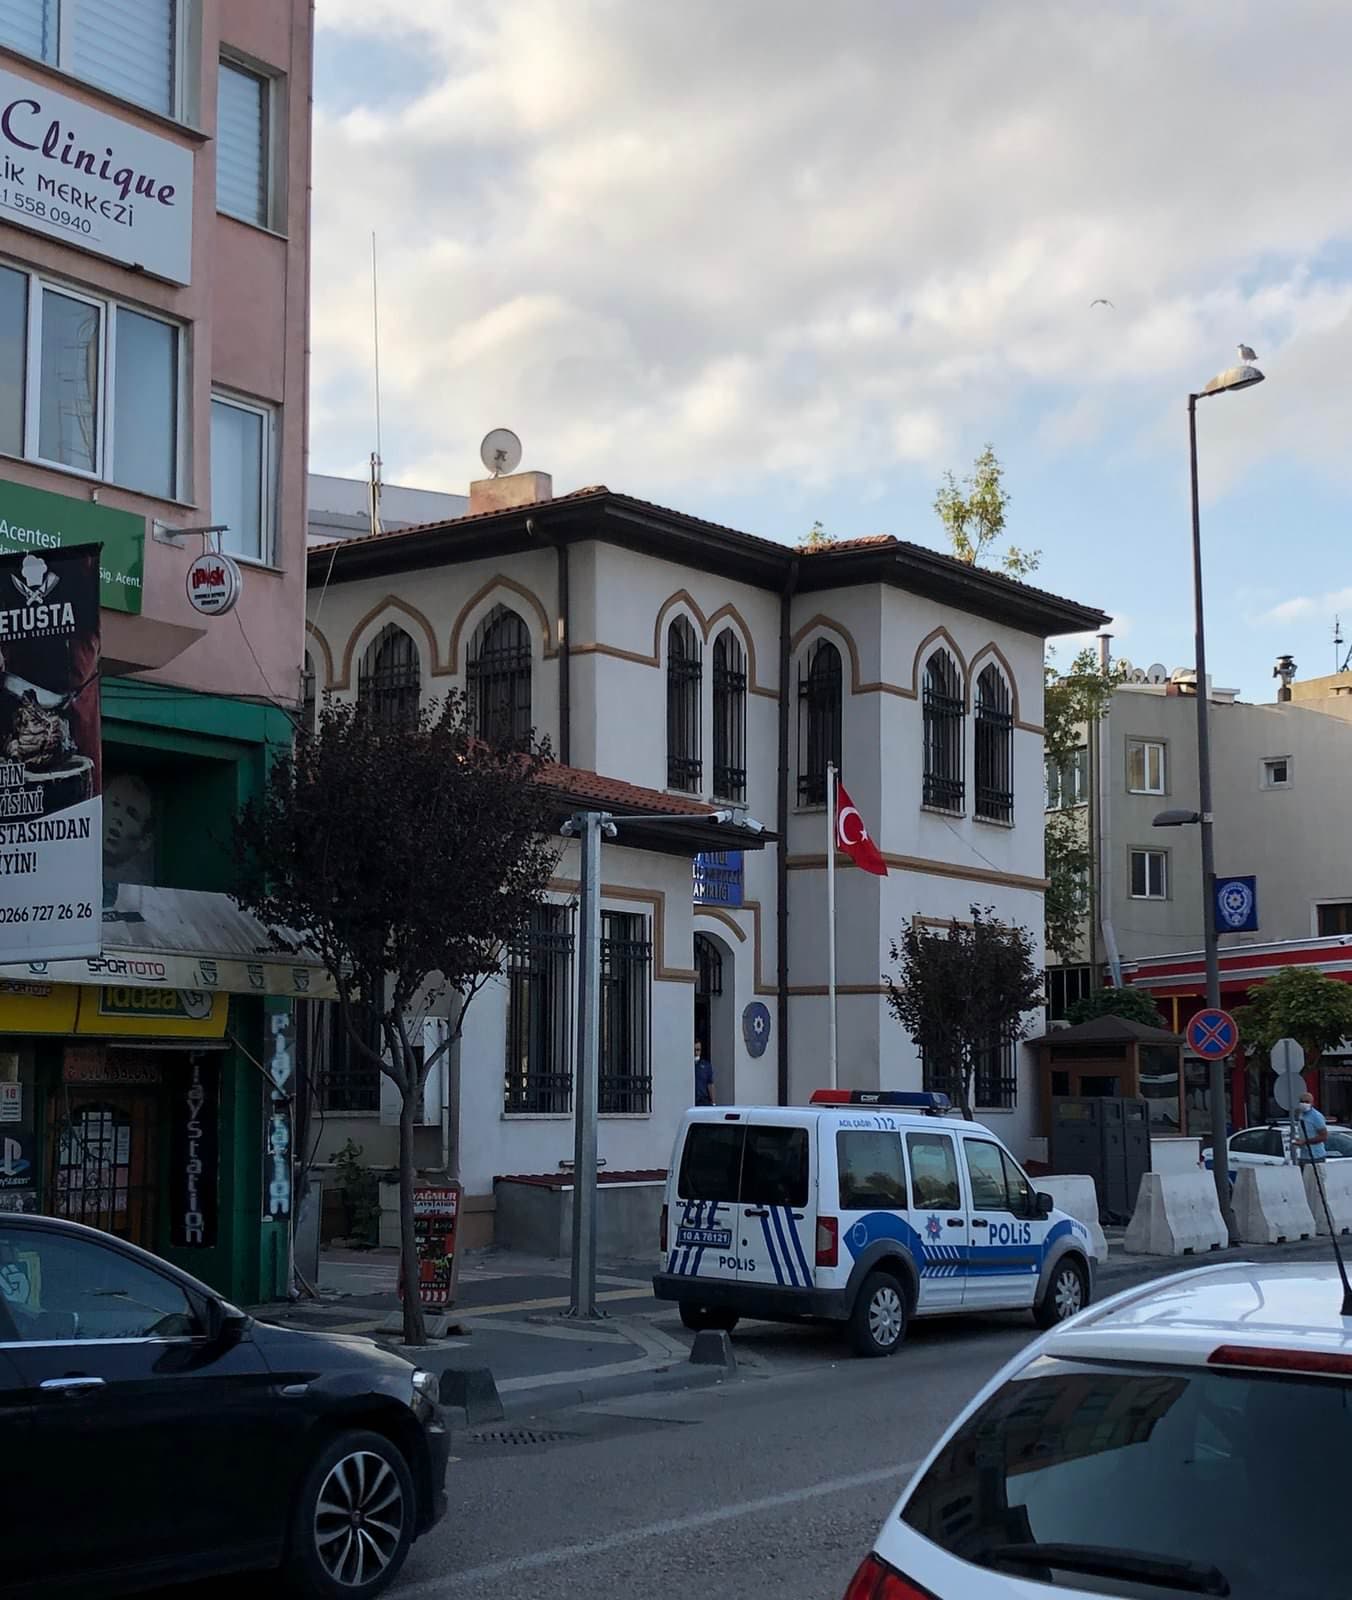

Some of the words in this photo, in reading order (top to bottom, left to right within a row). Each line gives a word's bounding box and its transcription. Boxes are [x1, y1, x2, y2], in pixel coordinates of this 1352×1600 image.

[1, 99, 176, 206] Clinique
[0, 155, 25, 186] İK
[37, 173, 134, 227] MERKEZİ
[14, 192, 46, 217] 558
[49, 207, 92, 234] 0940
[0, 519, 62, 549] Acentesi
[0, 906, 29, 924] 0266
[32, 905, 55, 921] 727
[58, 903, 74, 920] 26
[77, 902, 93, 919] 26
[87, 958, 165, 976] SPORTOTO
[873, 1116, 897, 1130] 112
